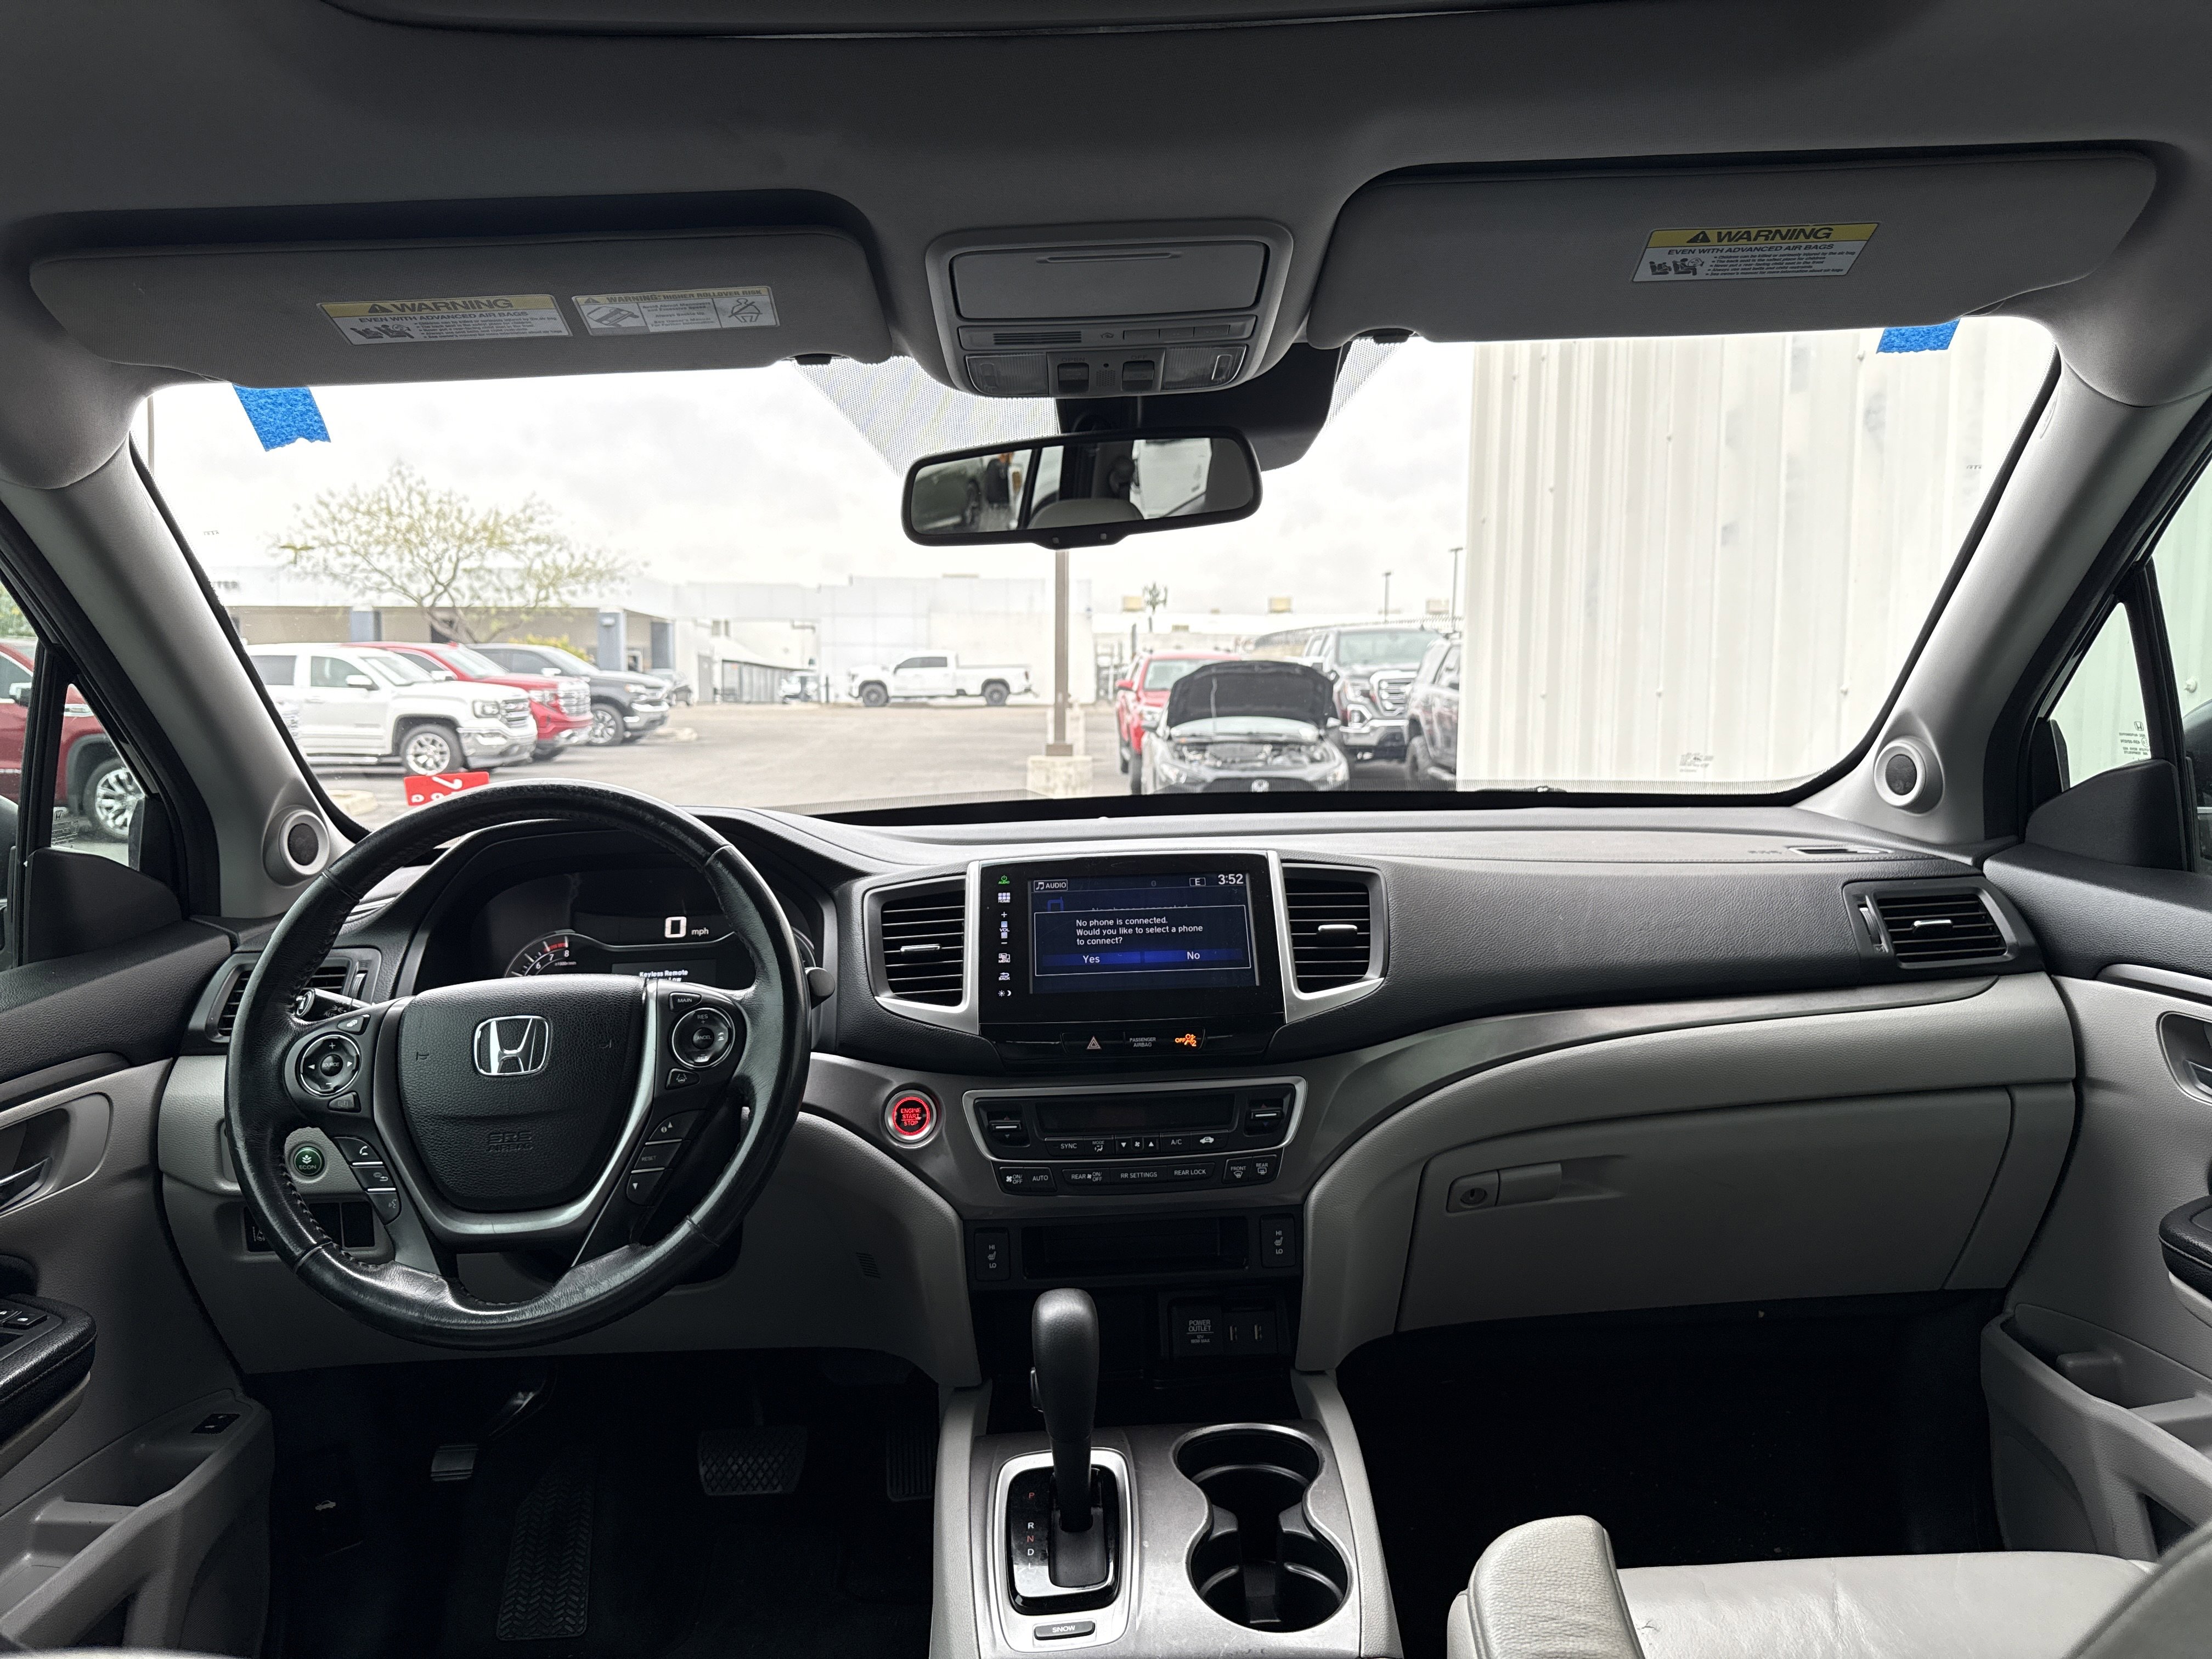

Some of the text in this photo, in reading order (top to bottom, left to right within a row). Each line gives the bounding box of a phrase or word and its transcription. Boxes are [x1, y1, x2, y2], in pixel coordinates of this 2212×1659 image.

[1717, 227, 1833, 243] WARNING
[391, 298, 514, 313] WARNING
[1218, 873, 1244, 885] 3:52
[665, 916, 709, 939] 0 mph
[1090, 918, 1114, 927] phone
[1125, 916, 1168, 925] connected.
[1076, 928, 1100, 936] Would
[1146, 925, 1169, 933] select
[1178, 924, 1203, 933] phone
[1087, 936, 1123, 945] connect?
[1082, 955, 1101, 964] Yes
[1187, 951, 1200, 960] No
[488, 1131, 533, 1143] SRS
[1052, 1624, 1076, 1633] SNOW
